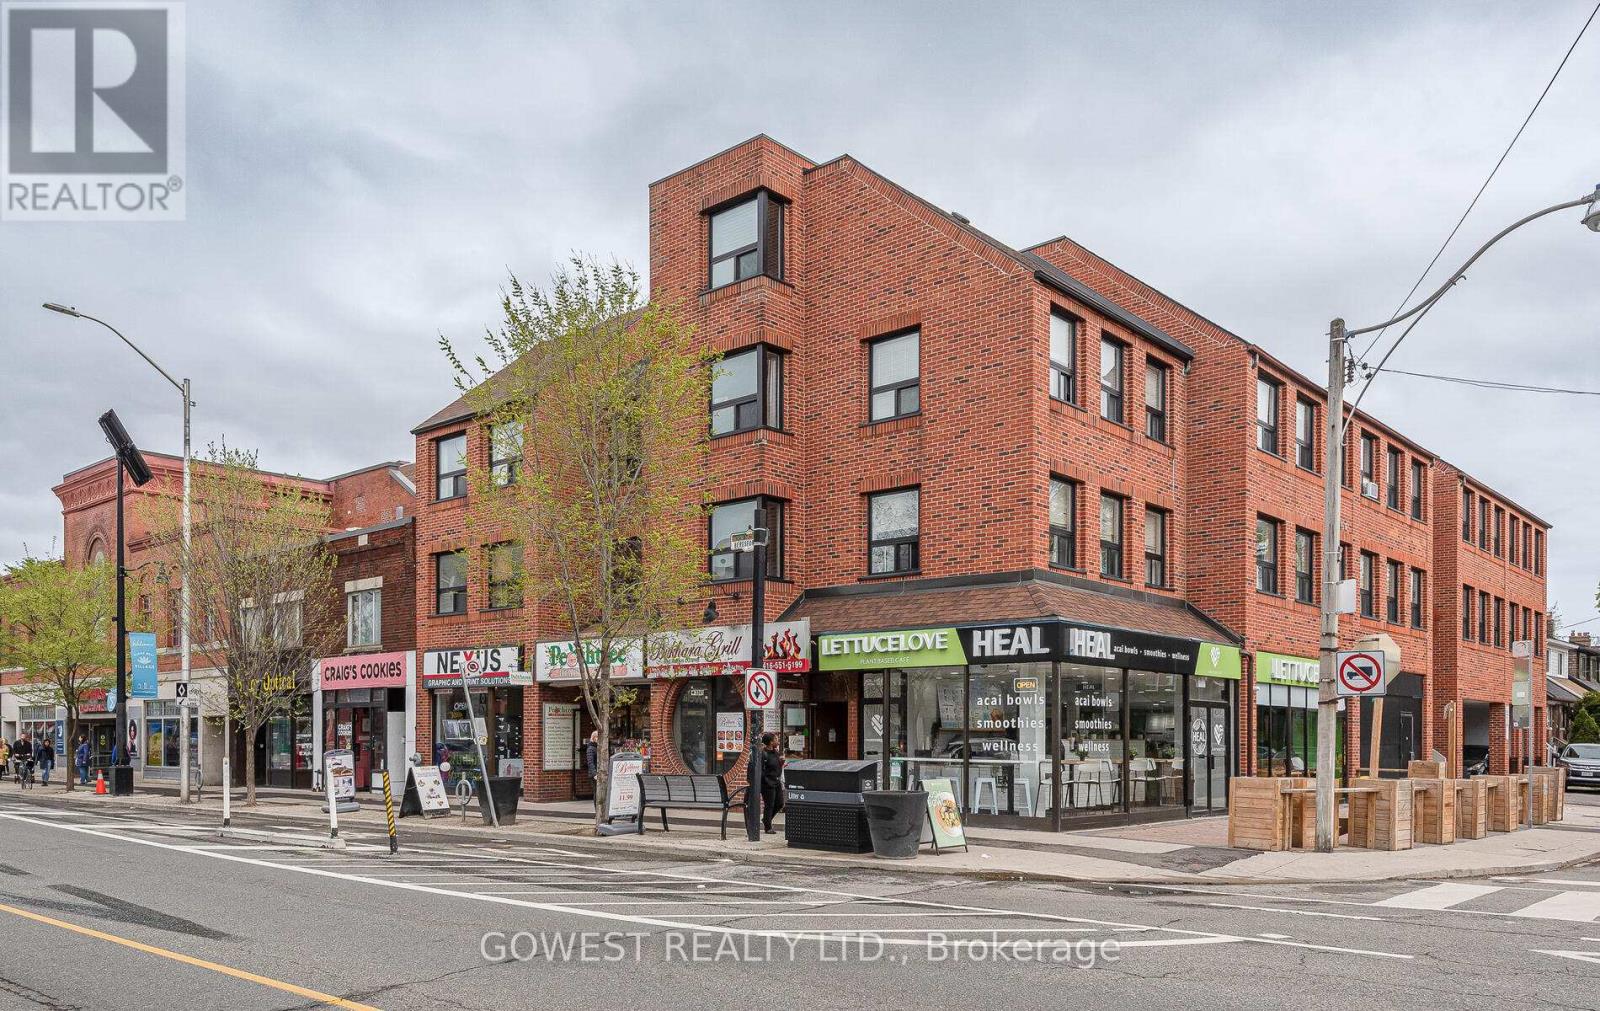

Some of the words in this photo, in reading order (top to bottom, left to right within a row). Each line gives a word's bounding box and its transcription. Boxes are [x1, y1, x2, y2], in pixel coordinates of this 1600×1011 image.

[703, 630, 743, 662] Grill
[821, 632, 949, 656] LETTUCELOVE
[973, 626, 1050, 657] HEAL
[1069, 628, 1116, 660] HEAL
[1113, 645, 1124, 653] acai
[1124, 645, 1138, 655] bowls
[1143, 648, 1167, 659] smoothies
[1171, 653, 1190, 661] wellness
[324, 664, 358, 682] CRAIG'S
[428, 679, 451, 687] GRAPHIC
[451, 678, 463, 686] AND
[464, 677, 480, 685] RINT
[1016, 681, 1036, 690] OPEN
[976, 694, 1002, 705] acai
[1006, 694, 1046, 705] bowls
[1074, 695, 1090, 707] acai
[1091, 695, 1113, 707] bowls
[976, 718, 1045, 729] smoothies
[1074, 719, 1112, 730] smoothies
[1191, 731, 1207, 743] HEAL
[982, 740, 1039, 752] wellness
[1078, 740, 1110, 752] wellness
